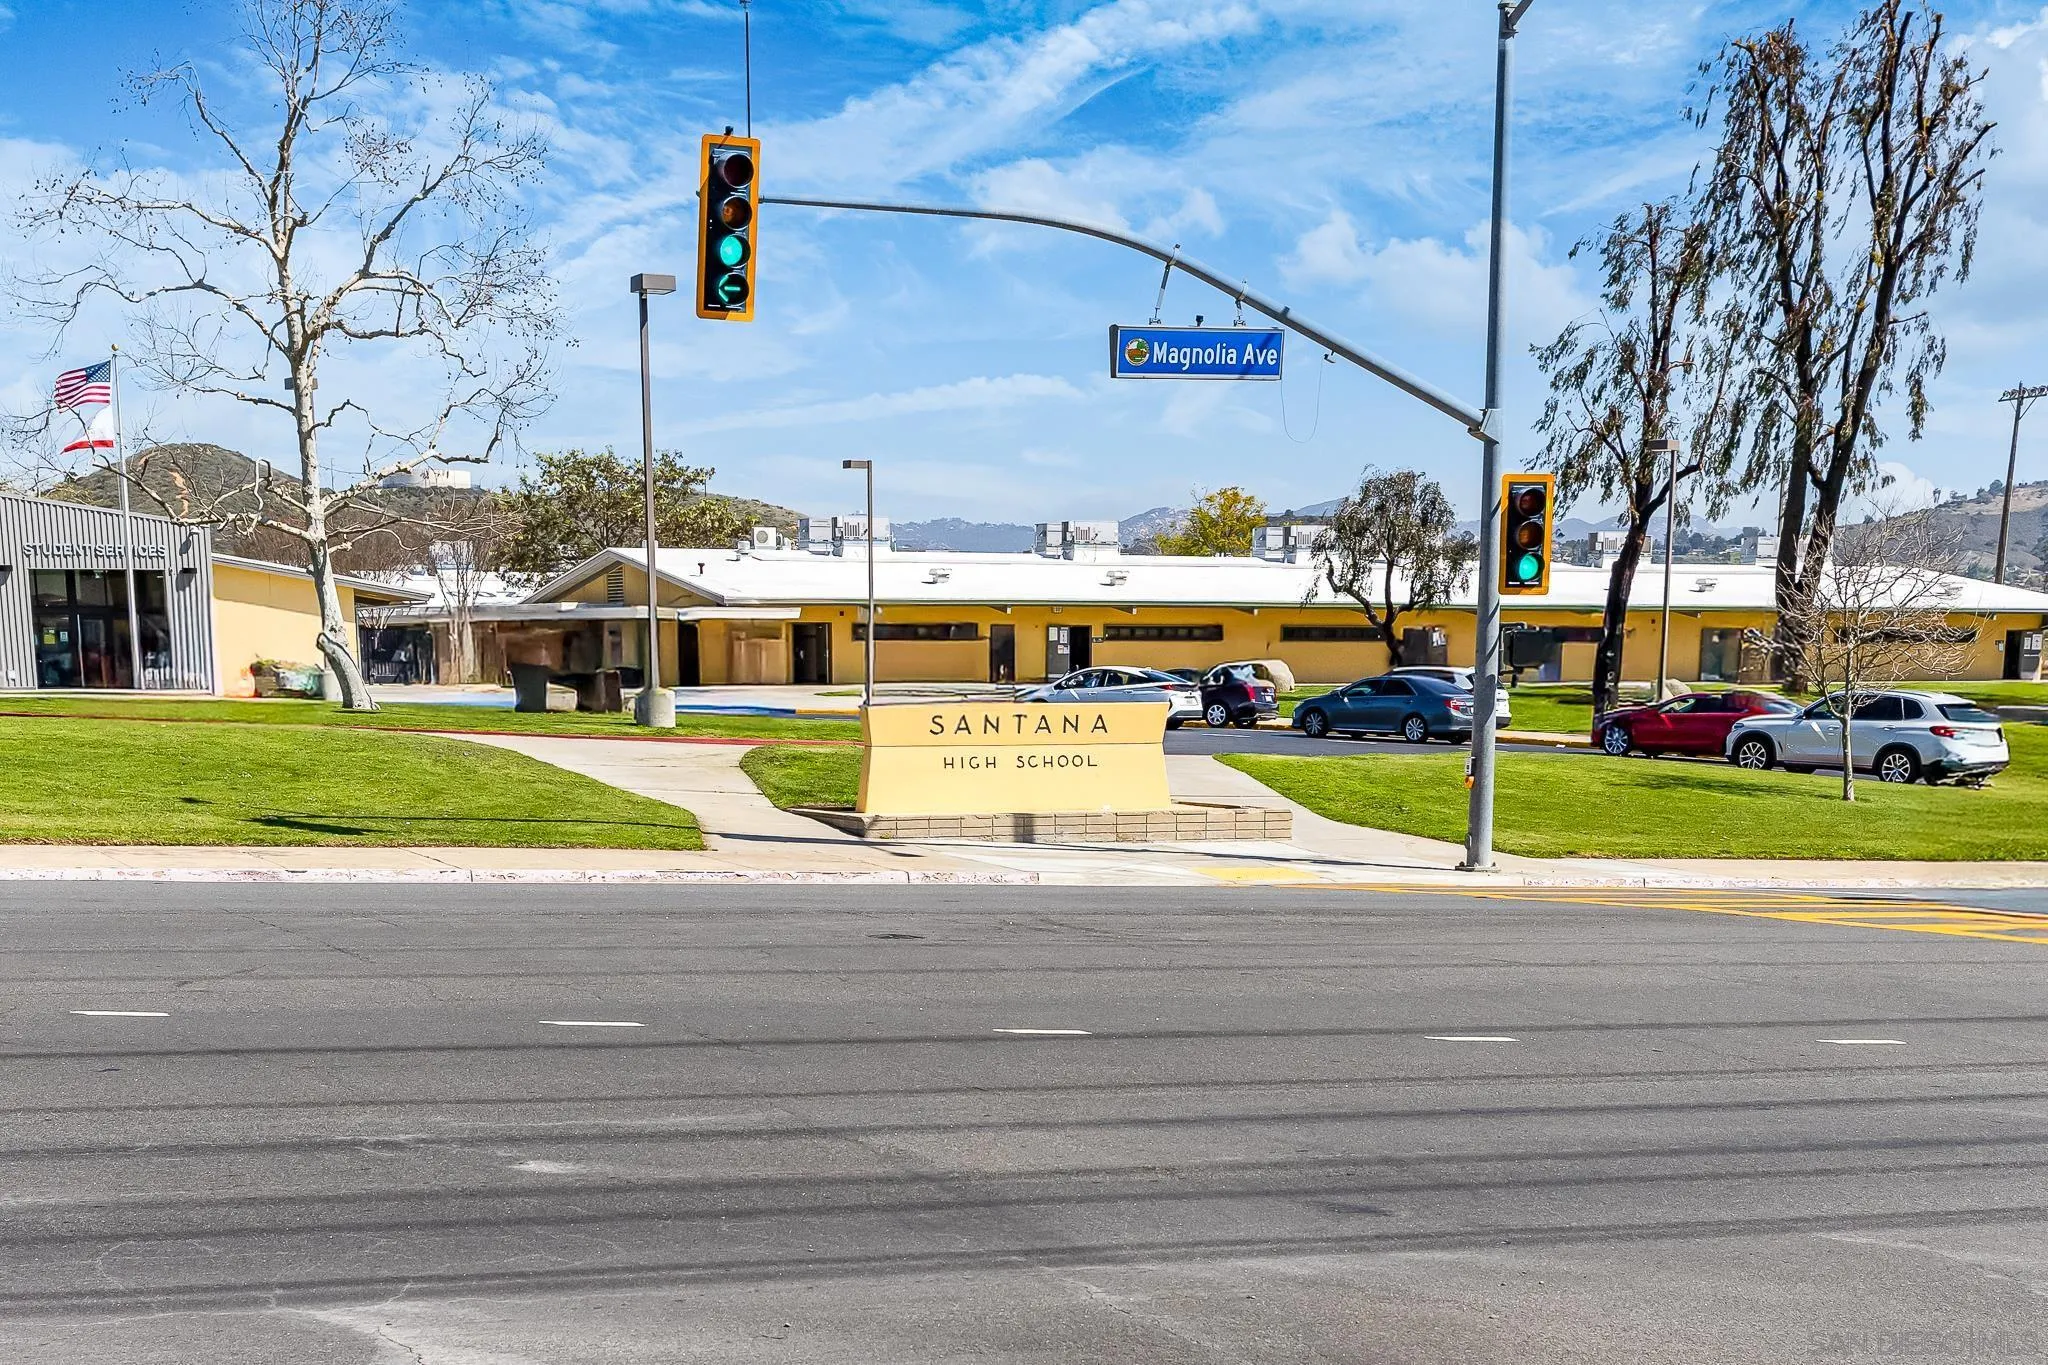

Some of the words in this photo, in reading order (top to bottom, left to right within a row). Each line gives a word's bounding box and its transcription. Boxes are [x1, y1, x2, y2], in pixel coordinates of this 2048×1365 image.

[1153, 342, 1237, 371] Magnolia
[1243, 343, 1278, 366] Ave
[23, 543, 92, 557] STUDENT
[95, 544, 166, 557] SERICES
[929, 713, 1109, 736] SANTANA
[943, 756, 997, 769] HIGH
[1016, 754, 1098, 769] SCHOOL
